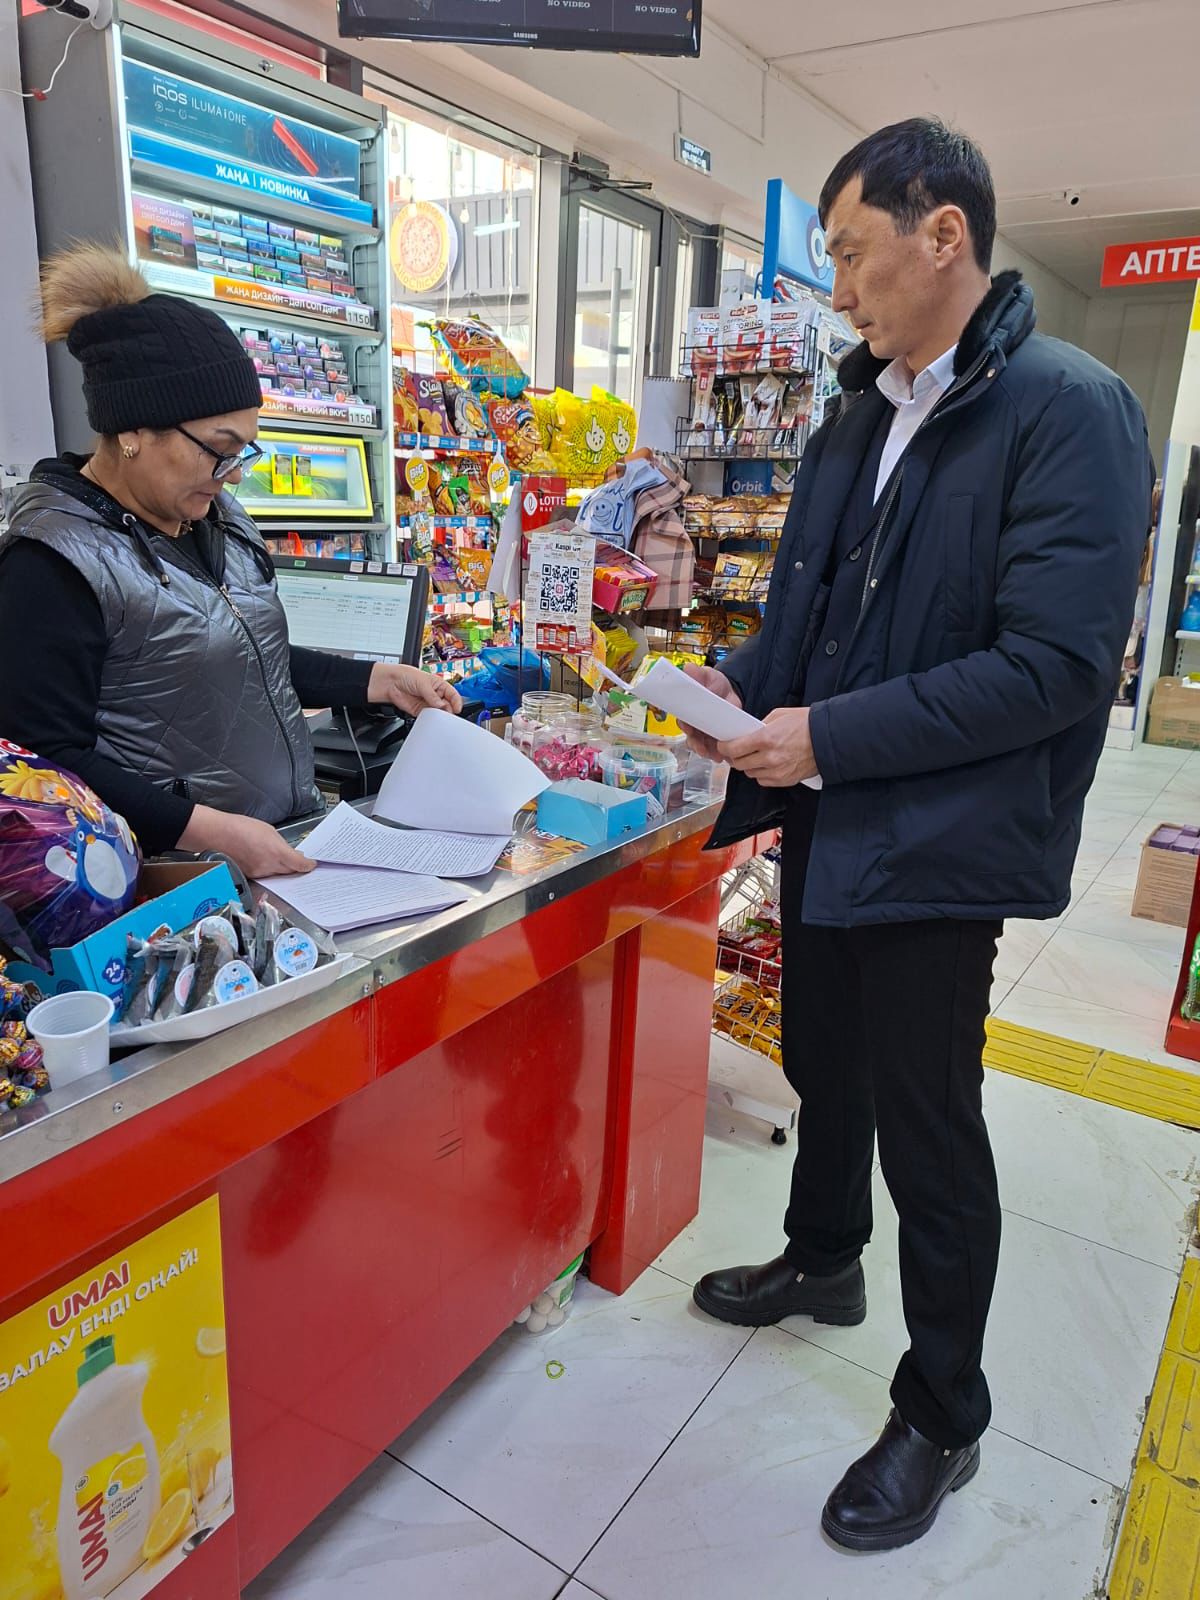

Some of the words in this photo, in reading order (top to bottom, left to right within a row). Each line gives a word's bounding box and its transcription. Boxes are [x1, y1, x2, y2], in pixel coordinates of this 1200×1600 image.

[563, 0, 591, 9] VIDEO
[650, 6, 678, 14] VIDEO
[152, 82, 188, 106] IQOS
[215, 163, 250, 185] ЖАҢА
[259, 178, 310, 202] НОВИНКА
[329, 407, 348, 418] ВКУС
[349, 412, 371, 425] 1150
[731, 479, 764, 494] Orbit
[540, 496, 566, 506] LOTTE
[105, 962, 121, 978] 24
[48, 1260, 131, 1330] UMAI
[80, 1293, 131, 1339] ЕНДІ
[134, 1247, 199, 1302] ОҢАЙ!
[77, 1490, 109, 1582] UMAI
